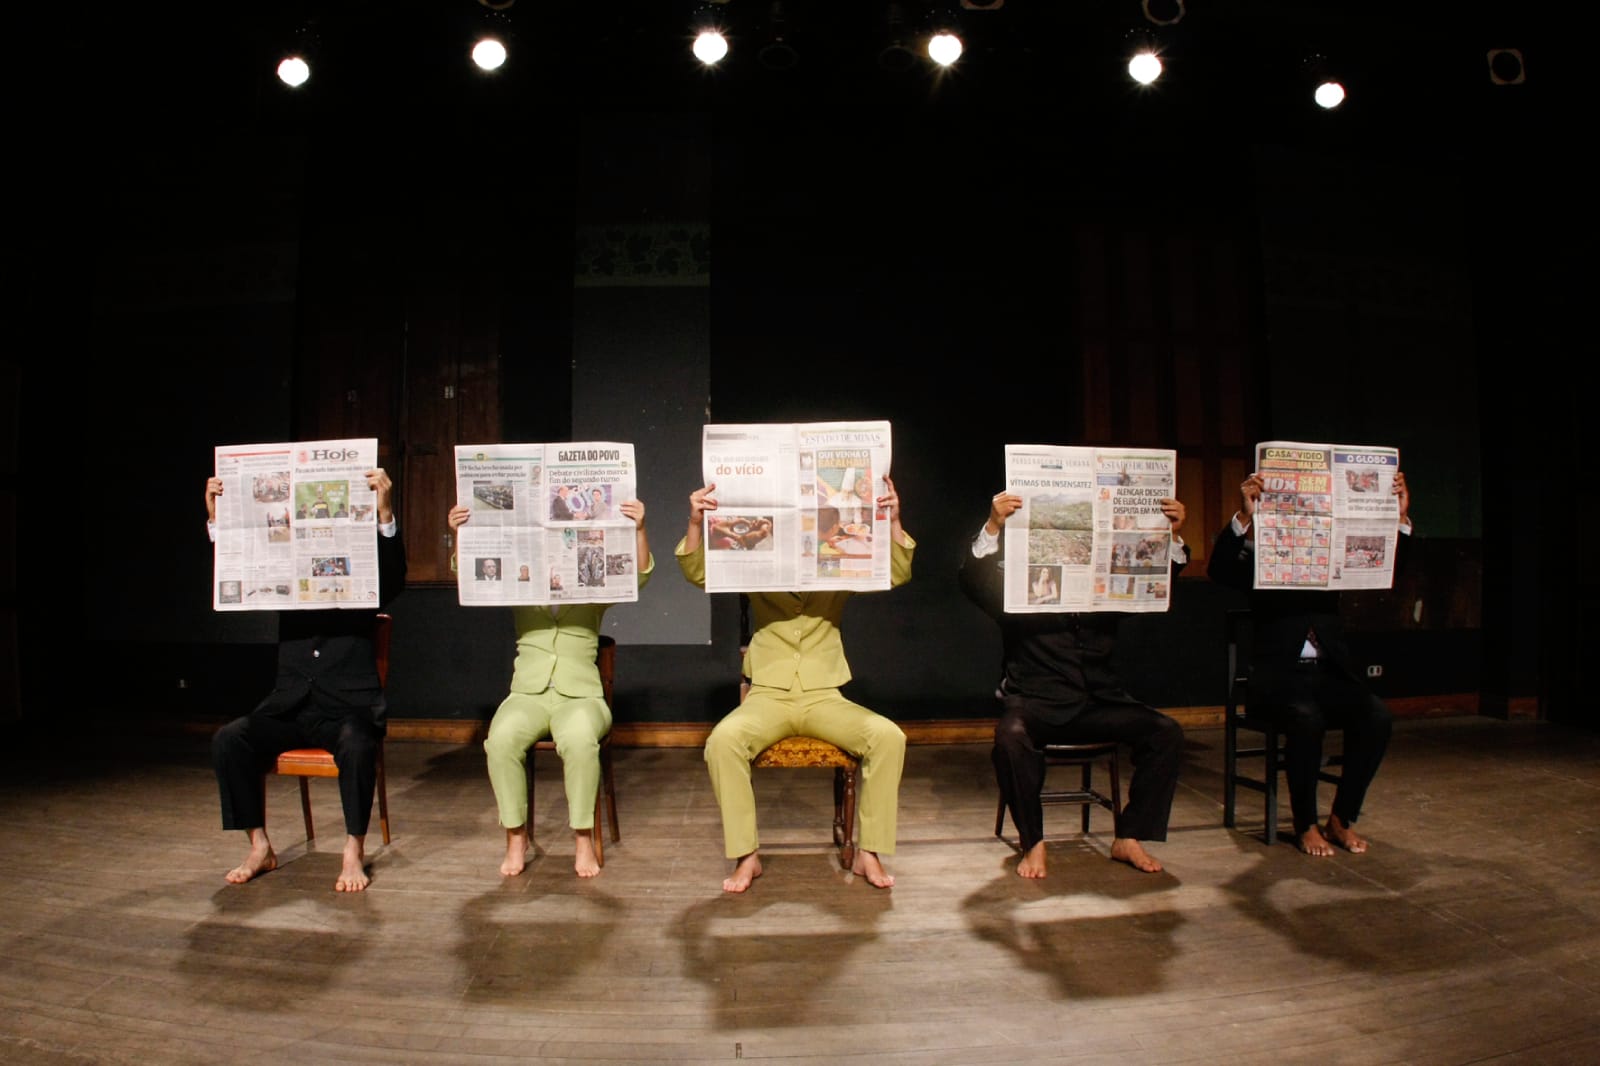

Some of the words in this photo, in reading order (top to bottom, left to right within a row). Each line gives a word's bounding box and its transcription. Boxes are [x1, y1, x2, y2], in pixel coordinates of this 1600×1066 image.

[806, 433, 839, 443] ESTADO
[841, 432, 851, 441] DE
[854, 432, 880, 441] MINAS
[312, 448, 359, 461] Hoje
[558, 450, 586, 462] GAZETA
[587, 450, 598, 461] DO
[599, 449, 620, 460] POVO
[819, 450, 833, 459] QUE
[834, 450, 861, 458] VENHA
[862, 450, 869, 458] O
[1267, 450, 1291, 458] CASA
[1298, 451, 1323, 460] VIDEO
[1347, 455, 1354, 463] O
[1356, 455, 1387, 464] GLOBO
[716, 464, 731, 475] do
[735, 463, 763, 475] vício
[1101, 461, 1132, 470] ESTADO
[1133, 461, 1143, 470] DE
[1146, 461, 1168, 471] MINAS
[571, 477, 600, 485] segundo
[1010, 478, 1039, 487] VÍTIMAS
[1040, 480, 1051, 488] DA
[1052, 480, 1092, 488] INSENSATEZ
[1264, 478, 1296, 490] 10x
[1299, 476, 1328, 484] SEM
[1117, 489, 1144, 497] ALENCAR
[1145, 489, 1169, 497] DESISTE
[1113, 497, 1121, 505] DE
